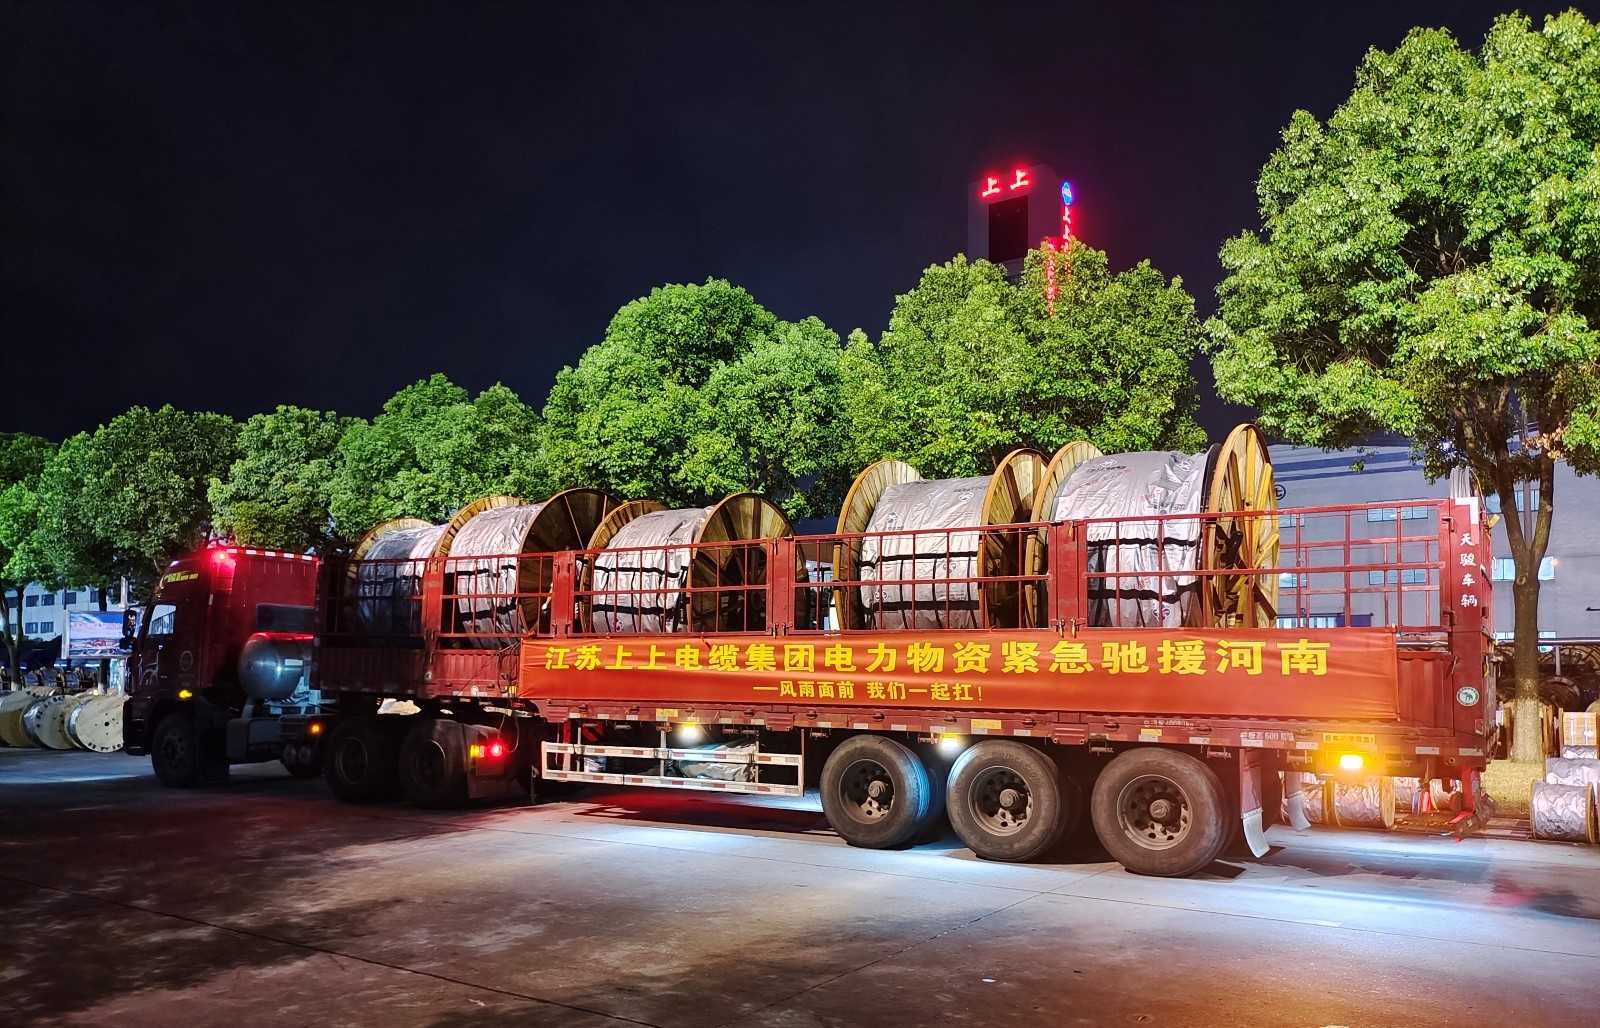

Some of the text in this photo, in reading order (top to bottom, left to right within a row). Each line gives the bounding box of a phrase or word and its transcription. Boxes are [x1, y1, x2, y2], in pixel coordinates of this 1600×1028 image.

[981, 169, 1029, 198] 上上
[1459, 532, 1478, 608] 天骏车辆
[544, 638, 1330, 677] 江苏上上电缆集团电力物资紧急驰援河南
